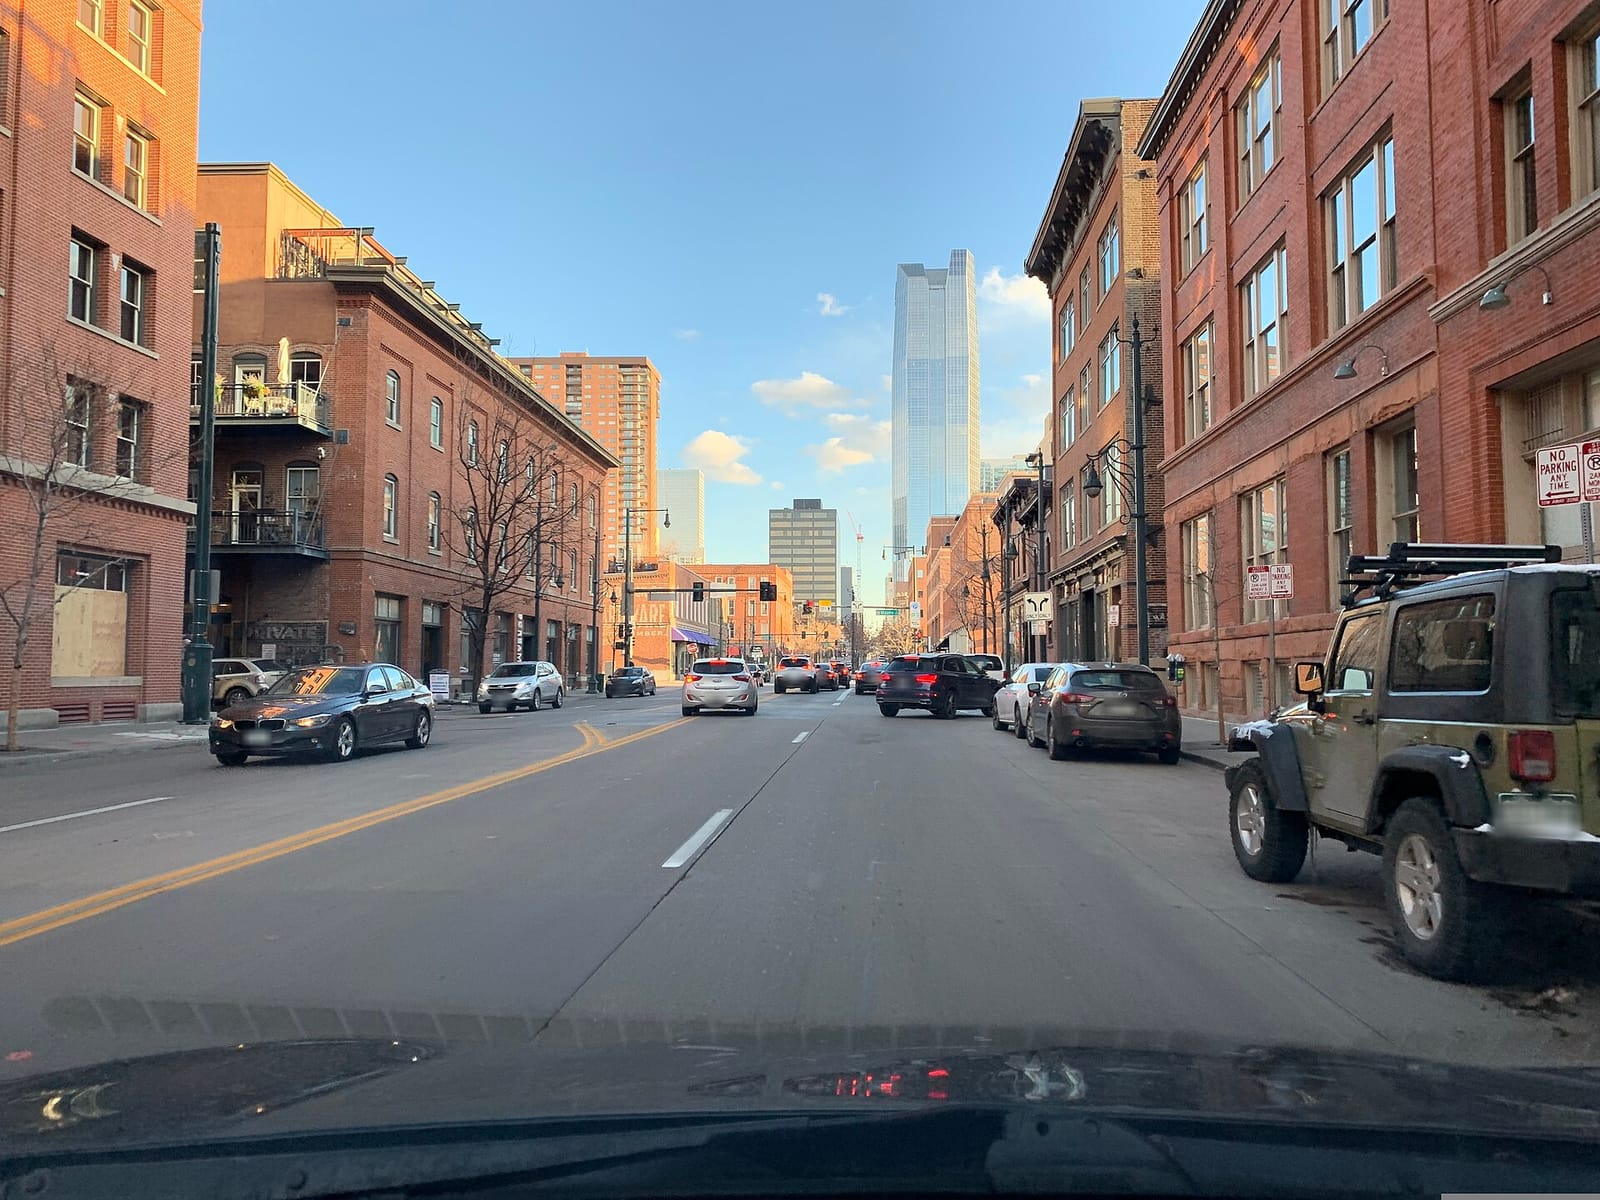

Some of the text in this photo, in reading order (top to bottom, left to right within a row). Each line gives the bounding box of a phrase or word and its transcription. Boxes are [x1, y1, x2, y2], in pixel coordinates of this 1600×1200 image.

[1550, 450, 1565, 462] NO
[1540, 460, 1577, 475] PARKING
[1550, 473, 1567, 482] ANY
[1549, 481, 1569, 491] TIME
